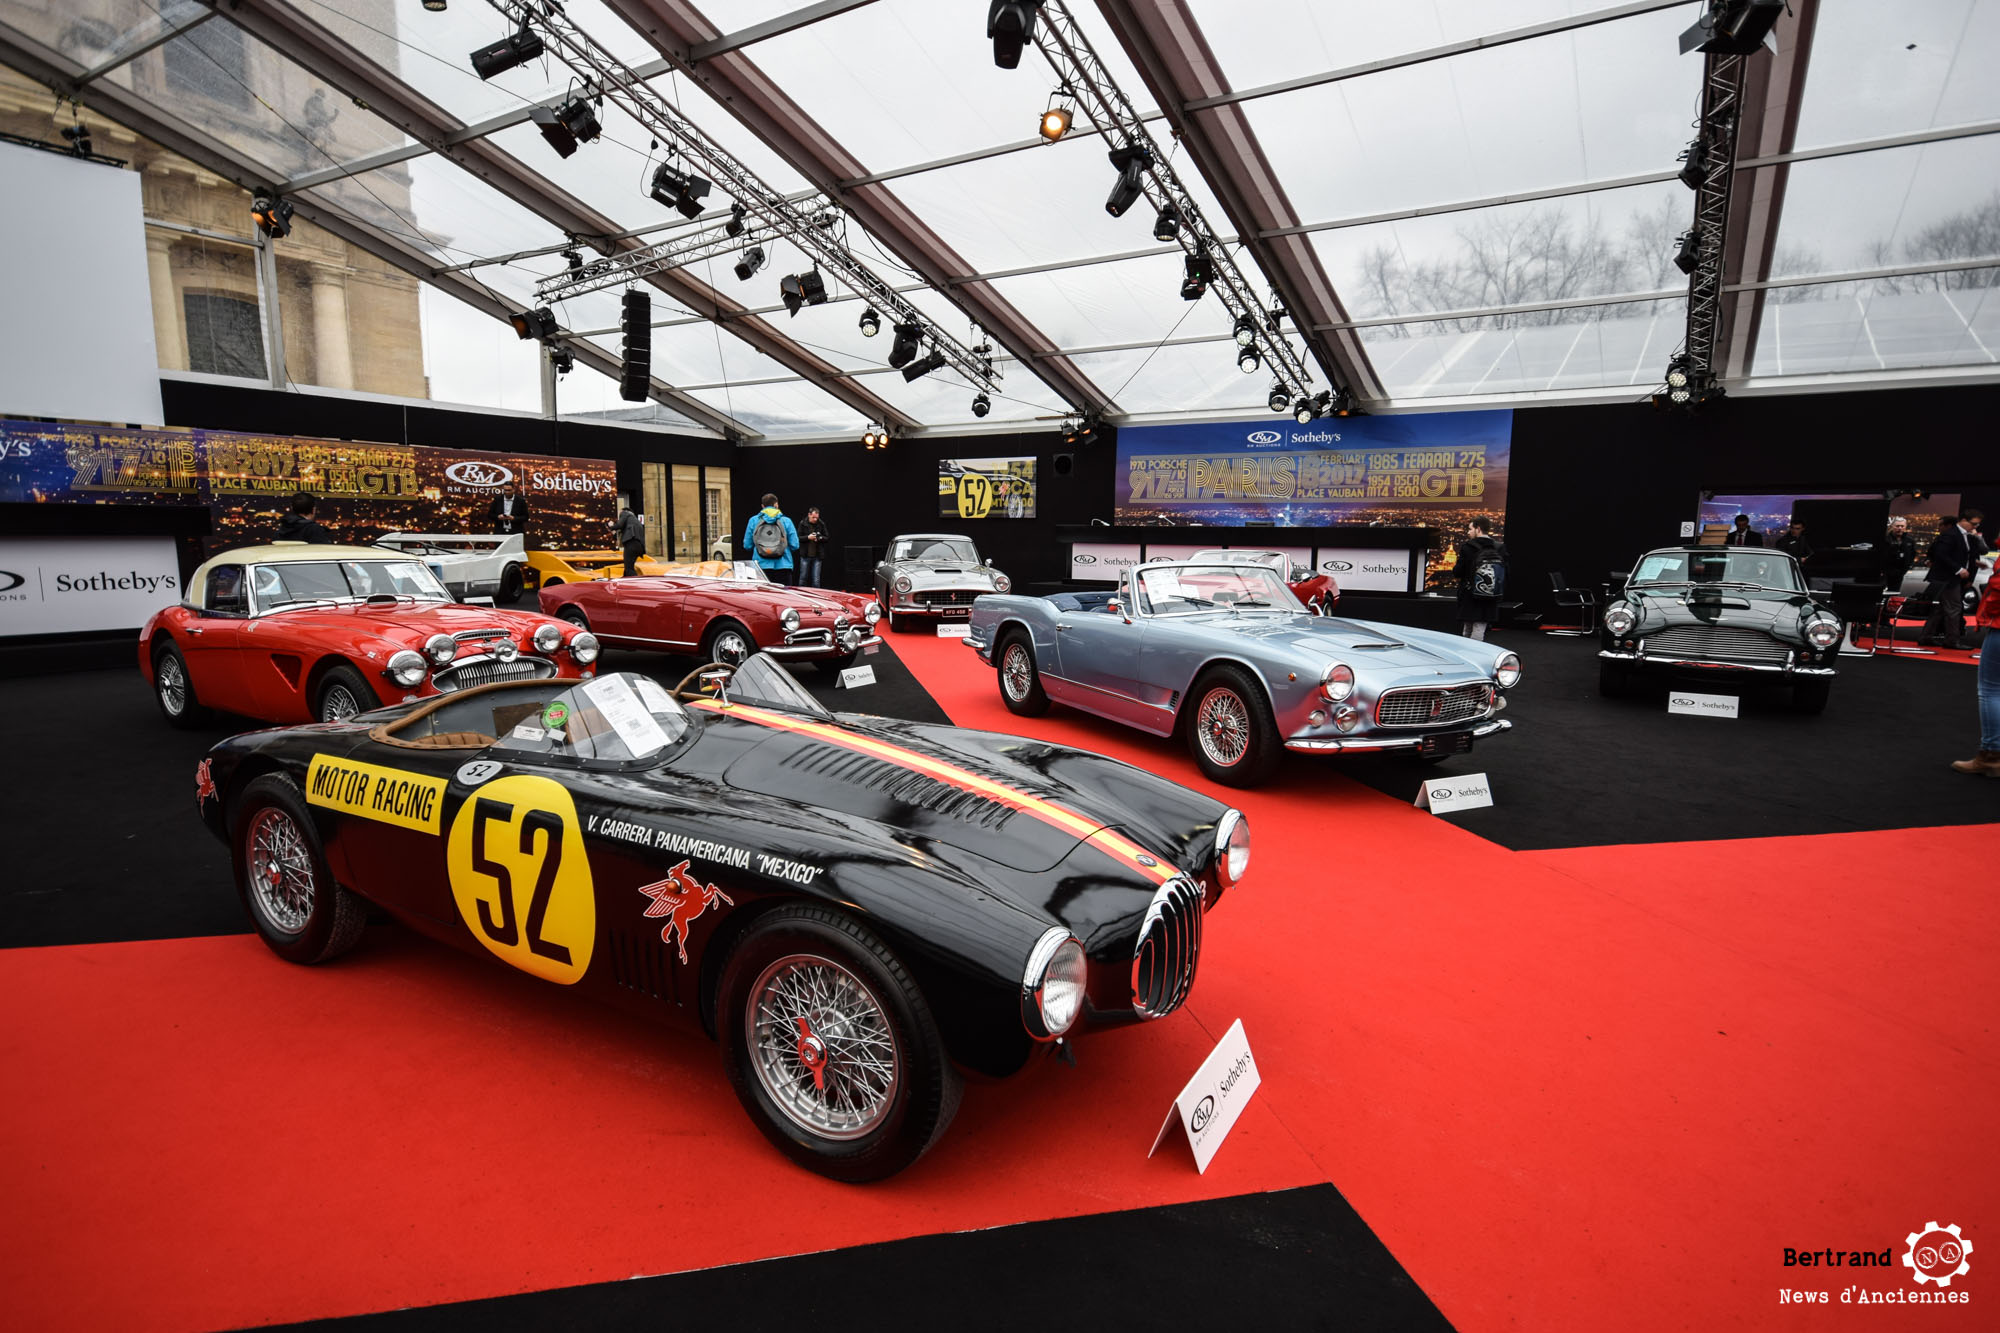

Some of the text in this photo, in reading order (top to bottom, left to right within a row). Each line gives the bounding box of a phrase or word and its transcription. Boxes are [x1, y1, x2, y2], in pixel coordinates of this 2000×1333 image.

[1291, 431, 1341, 444] Sotheby's
[239, 452, 295, 477] 2017
[392, 451, 415, 468] 275
[1149, 460, 1187, 470] PORSCHE
[1321, 454, 1366, 464] FEBRUARY
[1368, 451, 1486, 469] 1965 FERRARI 275
[329, 468, 355, 480] OSCA
[357, 465, 418, 494] GTB
[461, 465, 611, 496] RM Sotheby's
[1187, 456, 1296, 499] PARIS
[1320, 464, 1366, 485] 2017
[1368, 474, 1419, 486] 1954 OSCA
[1420, 468, 1484, 497] GTB
[209, 478, 298, 491] PLACE VAUBAN
[1297, 488, 1364, 498] PLACE VAUBAN
[1393, 486, 1419, 497] 1500
[964, 478, 986, 517] 52
[1104, 557, 1138, 568] Sotheby's
[1362, 564, 1407, 576] Sotheby's
[57, 571, 176, 594] Sotheby's
[312, 763, 437, 823] MOTOR RACING
[587, 815, 597, 833] V.
[600, 818, 652, 846] CARRERA
[654, 830, 751, 869] PANAMERICANA
[472, 796, 574, 967] 52
[1219, 1051, 1251, 1098] Sotheby's
